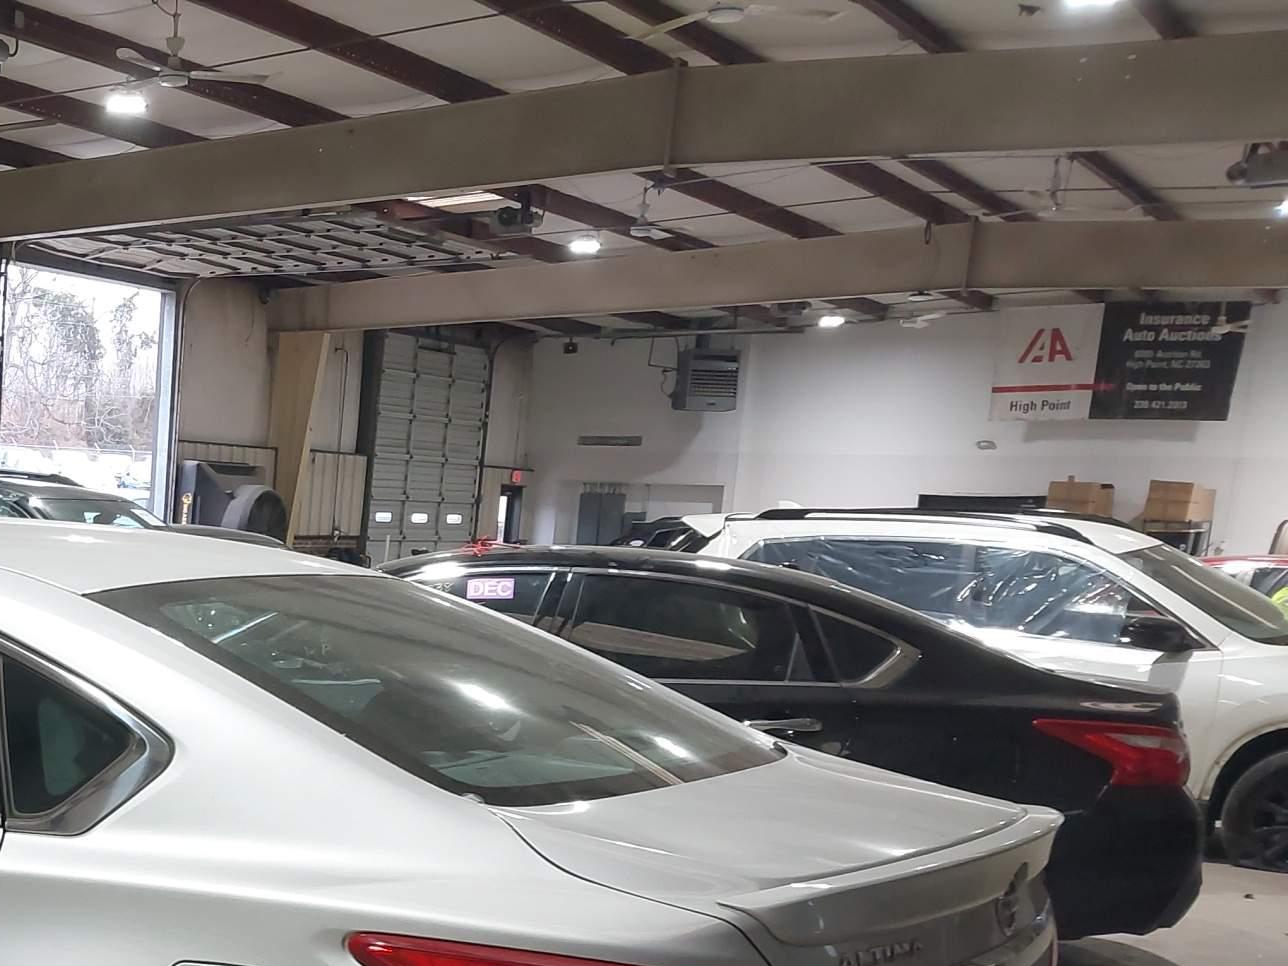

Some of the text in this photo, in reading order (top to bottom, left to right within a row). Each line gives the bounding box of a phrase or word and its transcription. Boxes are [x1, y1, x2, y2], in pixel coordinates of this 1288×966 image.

[1139, 311, 1212, 326] Insurance
[1122, 327, 1223, 343] Auto Auctions
[1009, 399, 1071, 414] High Point
[469, 581, 511, 597] DEC
